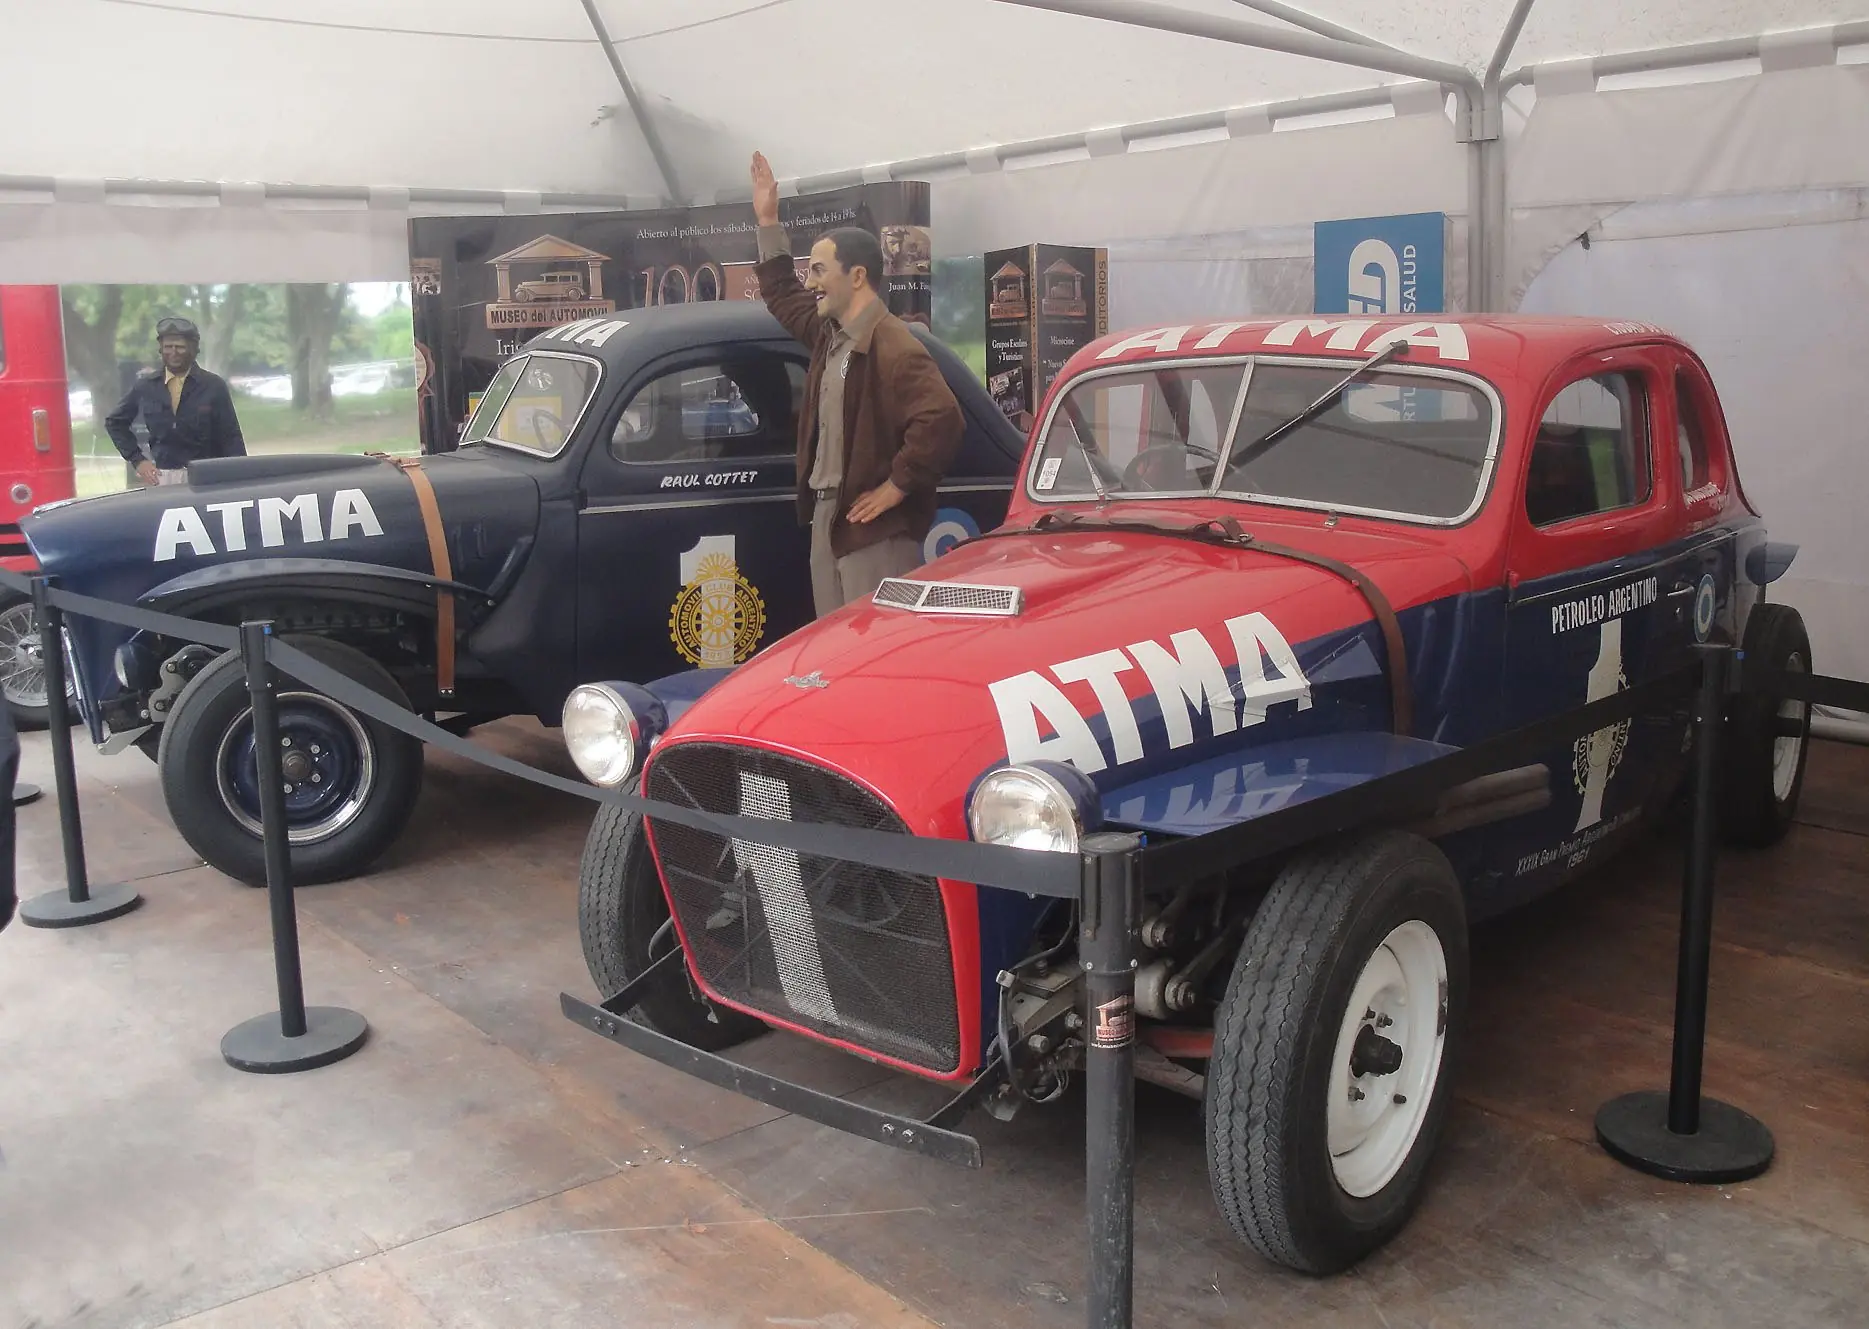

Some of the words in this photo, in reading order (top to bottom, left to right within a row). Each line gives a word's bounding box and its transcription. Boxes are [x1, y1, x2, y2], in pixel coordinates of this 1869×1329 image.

[636, 229, 668, 240] Abierto
[670, 228, 678, 237] al
[679, 226, 709, 240] público
[710, 225, 722, 235] los
[641, 262, 721, 309] 100
[888, 281, 906, 292] Juan
[908, 281, 919, 290] M.
[1403, 243, 1416, 313] SALUD
[490, 309, 527, 324] MUSEO
[531, 310, 546, 322] del
[1095, 318, 1471, 361] ATMA
[992, 339, 1009, 350] Grupos
[660, 474, 700, 488] RAUL
[705, 471, 758, 486] COTTET
[153, 488, 384, 562] ATMA
[680, 534, 736, 668] 1
[736, 589, 757, 647] ARGENTINO
[1551, 595, 1605, 634] PETROLEO
[1608, 576, 1657, 618] ARGENTINO
[987, 611, 1312, 776] ATMA
